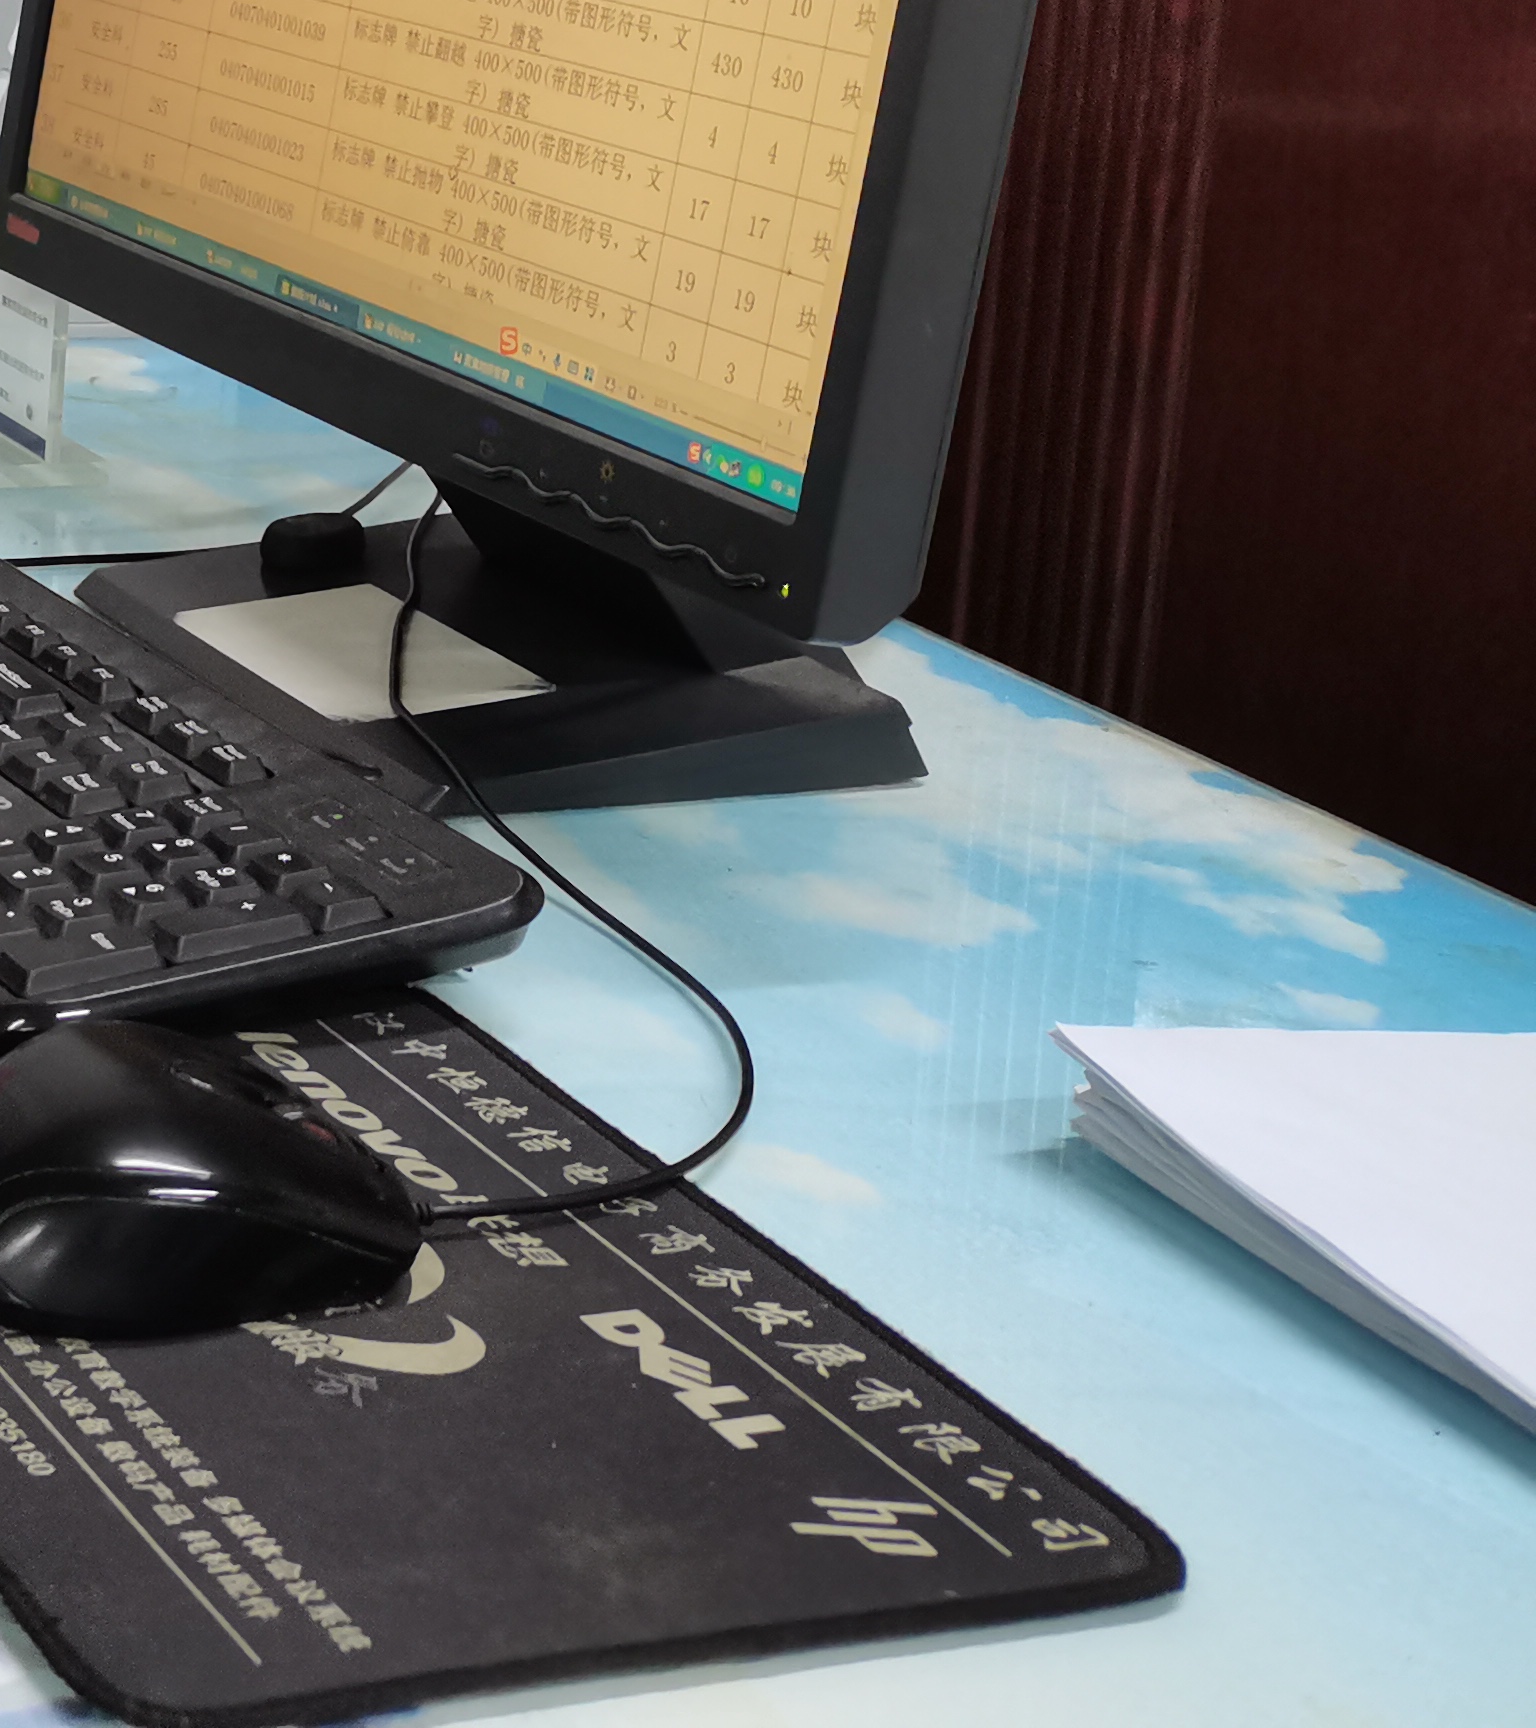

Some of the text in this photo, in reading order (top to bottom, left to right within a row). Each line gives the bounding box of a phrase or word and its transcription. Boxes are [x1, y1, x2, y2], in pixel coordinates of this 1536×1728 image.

[854, 3, 878, 35] 块
[710, 51, 743, 79] 430
[770, 65, 804, 93] 430
[840, 79, 862, 109] 块
[708, 125, 719, 149] 4
[767, 141, 778, 165] 4
[825, 155, 849, 186] 块
[688, 198, 710, 222] 17
[746, 215, 771, 239] 17
[811, 230, 833, 262] 块
[675, 269, 696, 294] 19
[733, 288, 756, 314] 19
[796, 305, 818, 338] 块
[665, 340, 677, 363] 3
[724, 362, 736, 385] 3
[781, 380, 802, 413] 块
[233, 1031, 458, 1191] lenovo
[24, 1358, 113, 1436] 办公设备
[580, 1308, 786, 1450] DELL
[789, 1496, 938, 1558] hp
